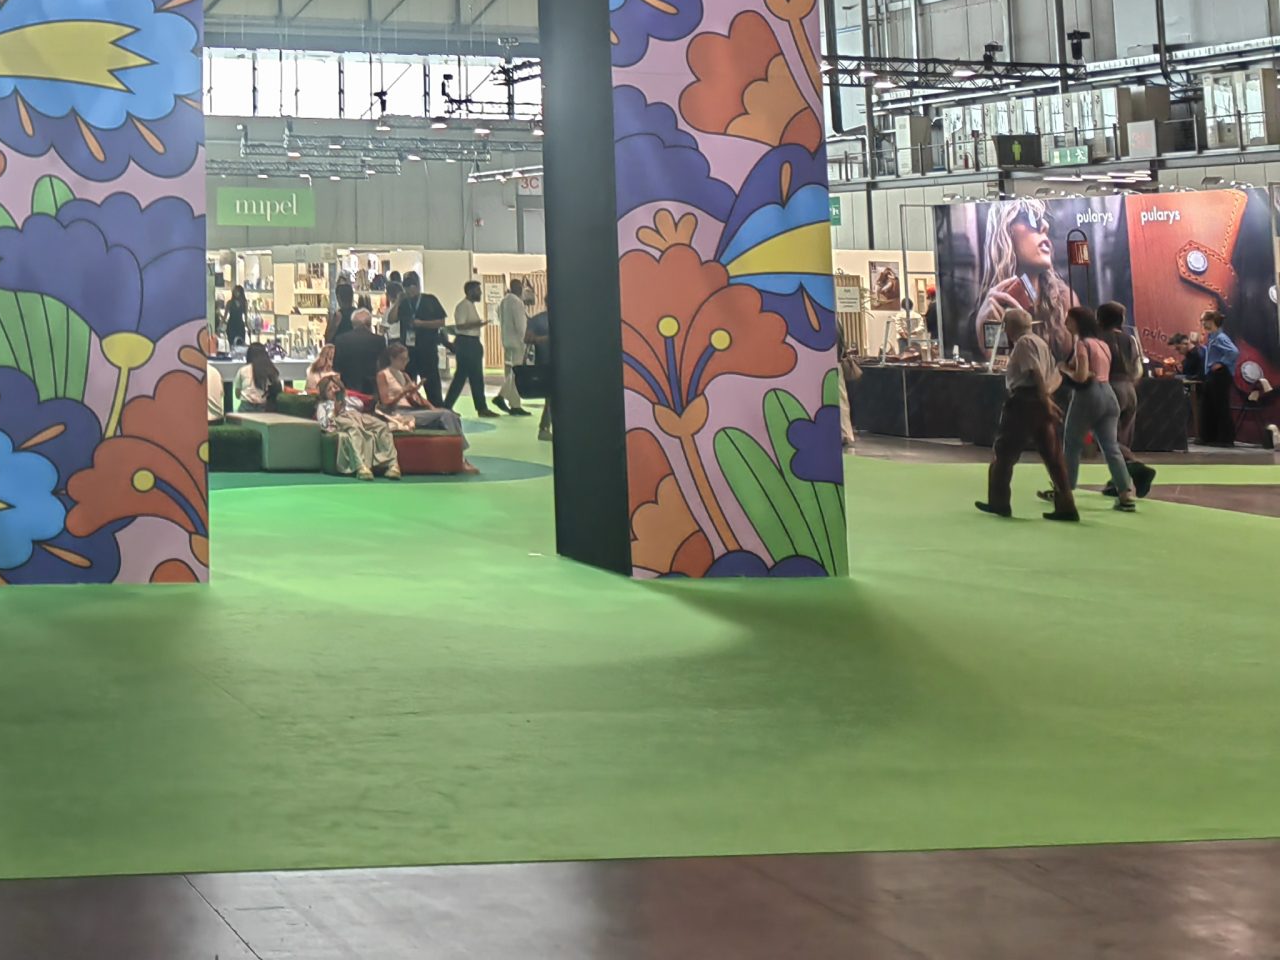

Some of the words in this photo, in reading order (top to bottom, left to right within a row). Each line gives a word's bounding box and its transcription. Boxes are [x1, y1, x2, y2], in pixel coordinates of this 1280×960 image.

[520, 176, 540, 189] 3C
[235, 192, 297, 222] mipel
[1076, 207, 1114, 227] pularys
[1140, 205, 1181, 226] pularys
